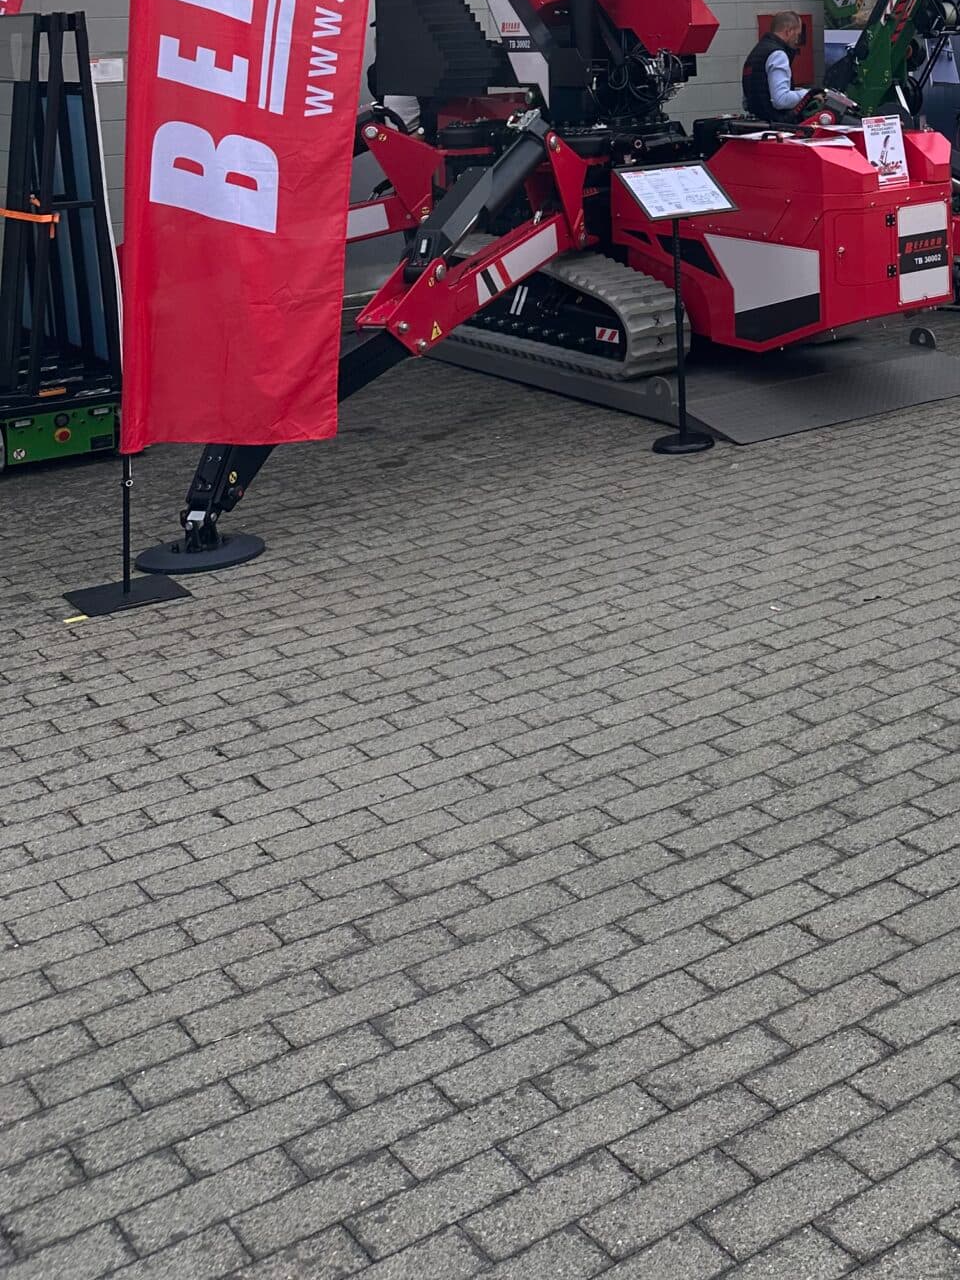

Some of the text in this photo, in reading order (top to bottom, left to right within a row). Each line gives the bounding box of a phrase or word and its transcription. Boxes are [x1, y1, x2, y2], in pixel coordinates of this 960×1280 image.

[905, 237, 942, 253] BEFARD
[914, 254, 942, 265] TB 30002
